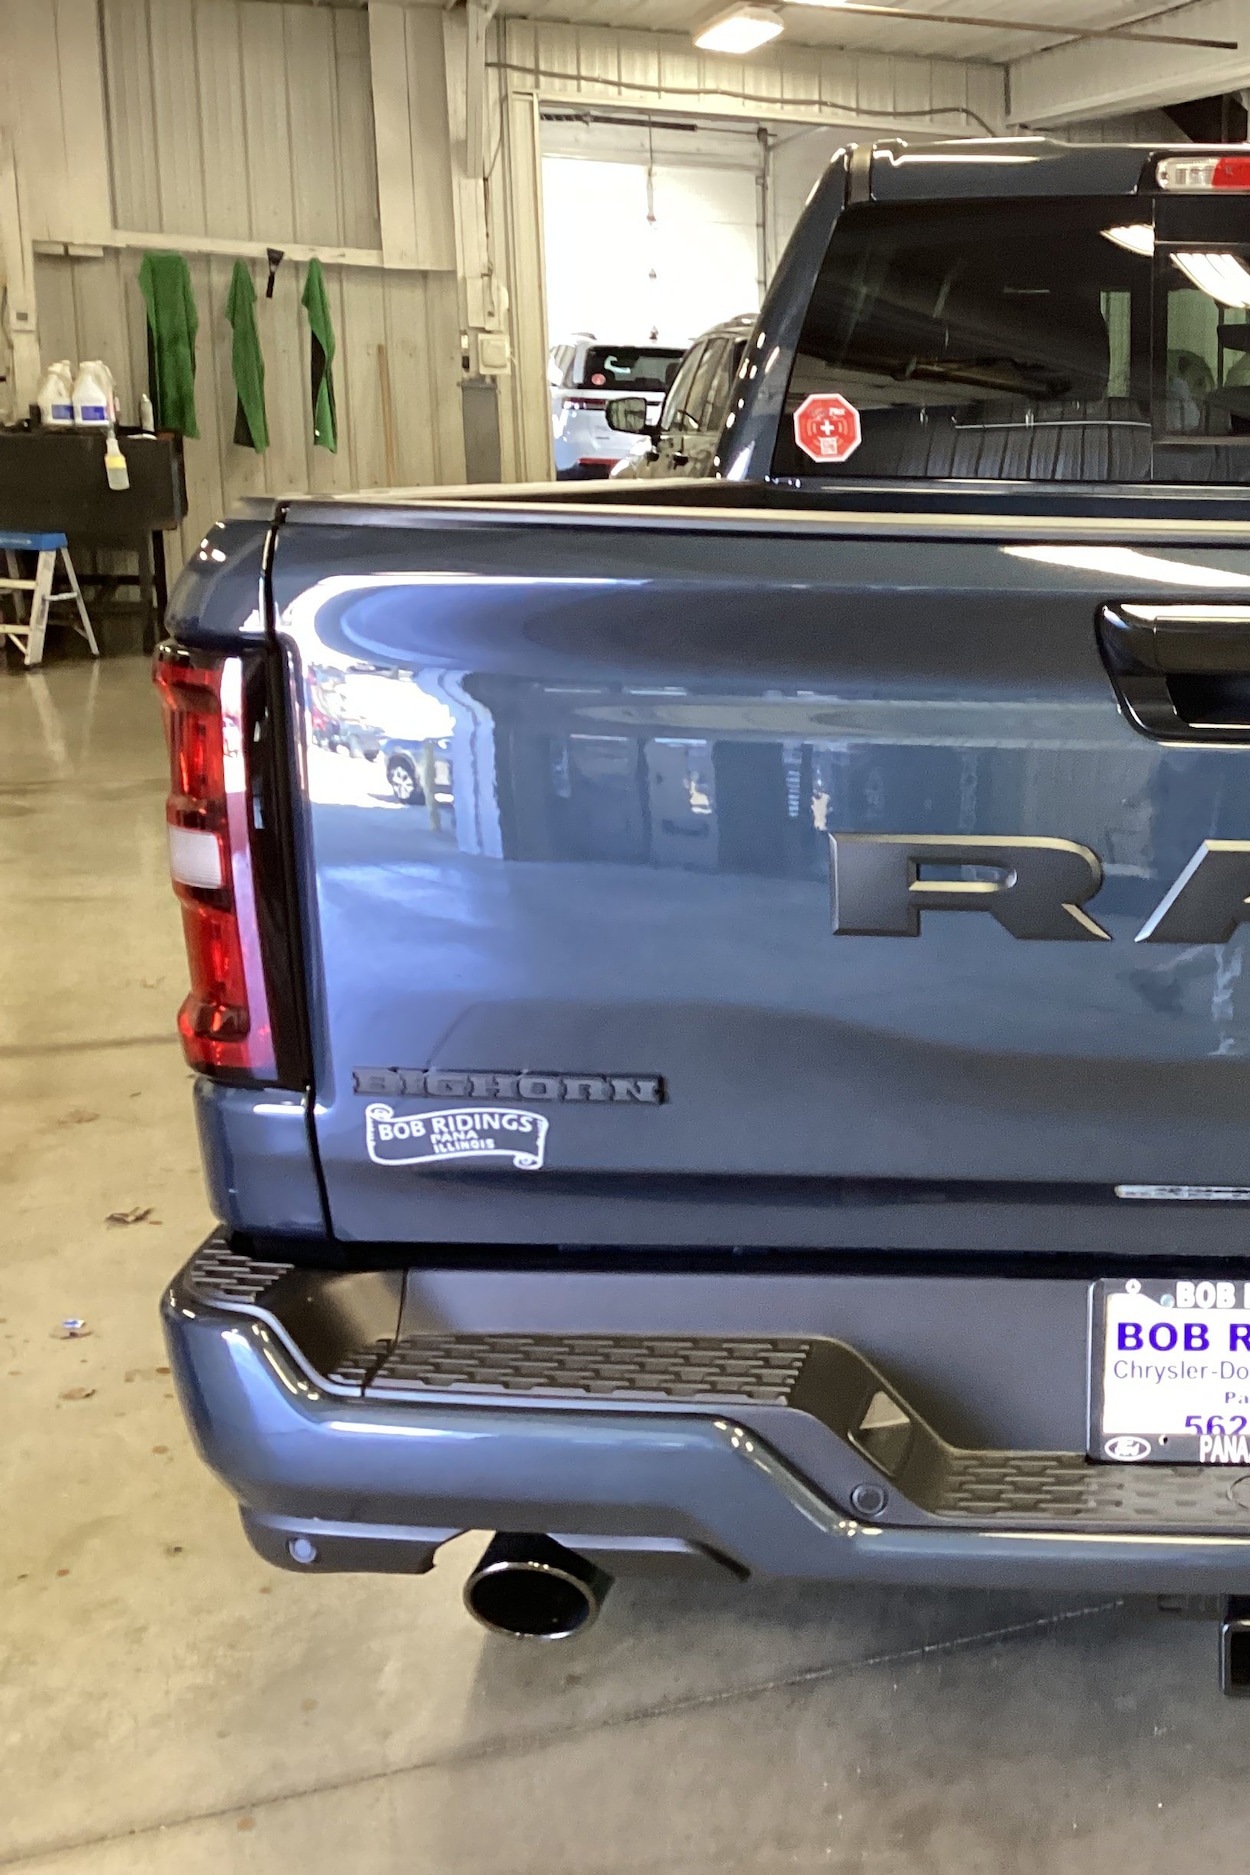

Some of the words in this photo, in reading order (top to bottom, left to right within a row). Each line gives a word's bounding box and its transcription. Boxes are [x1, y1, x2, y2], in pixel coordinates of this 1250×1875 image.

[352, 1067, 669, 1104] BIGHORN
[378, 1120, 426, 1141] BOB
[431, 1113, 533, 1134] RIDINGS
[430, 1130, 480, 1144] PANA
[433, 1138, 496, 1154] ILLINOIS
[1175, 1281, 1236, 1309] BOB
[1117, 1322, 1210, 1352] BOB
